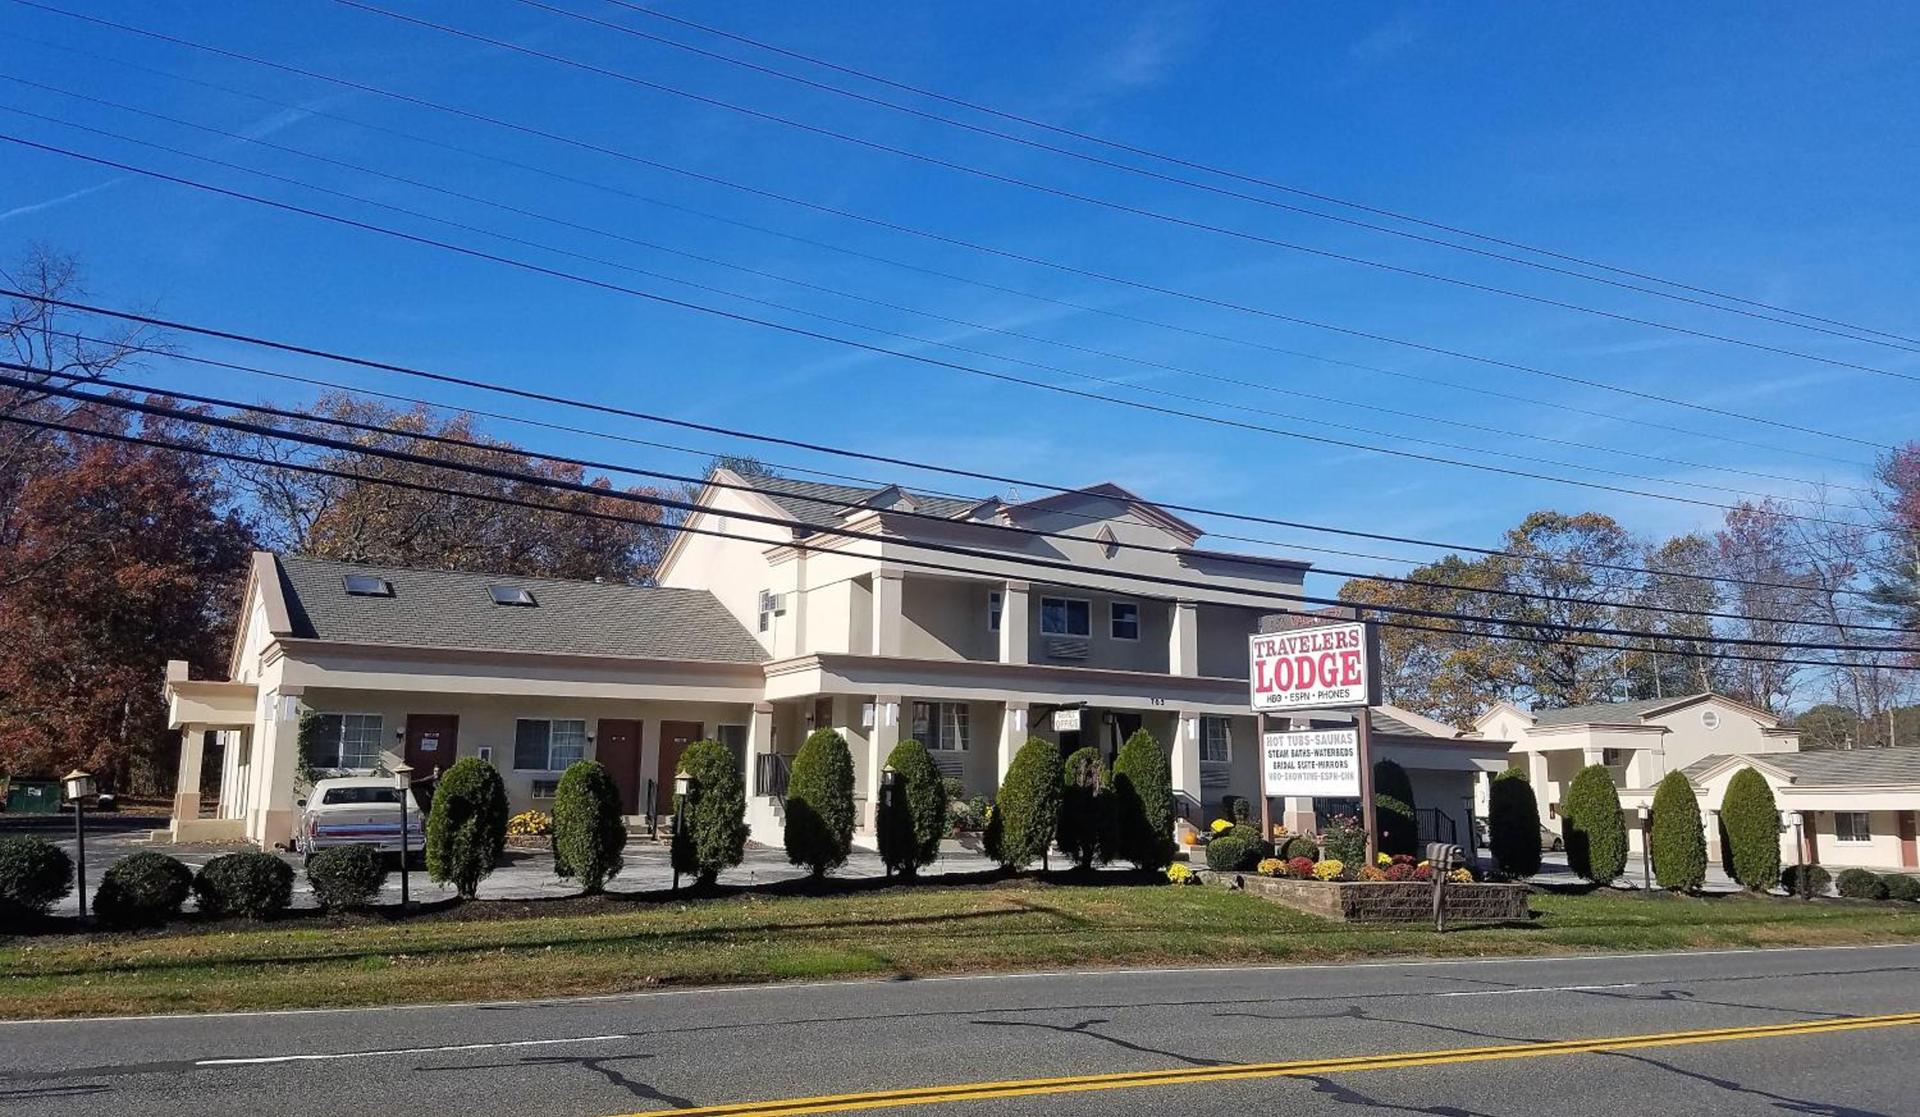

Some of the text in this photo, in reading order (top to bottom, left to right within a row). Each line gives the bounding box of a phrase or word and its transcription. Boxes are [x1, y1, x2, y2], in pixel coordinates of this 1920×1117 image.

[1254, 629, 1360, 658] TRAVELERS
[1255, 650, 1362, 693] LODGE
[1289, 692, 1310, 701] ESPN
[1317, 689, 1350, 699] PHONES
[1266, 736, 1284, 747] HOT
[1268, 749, 1289, 758] STEAM
